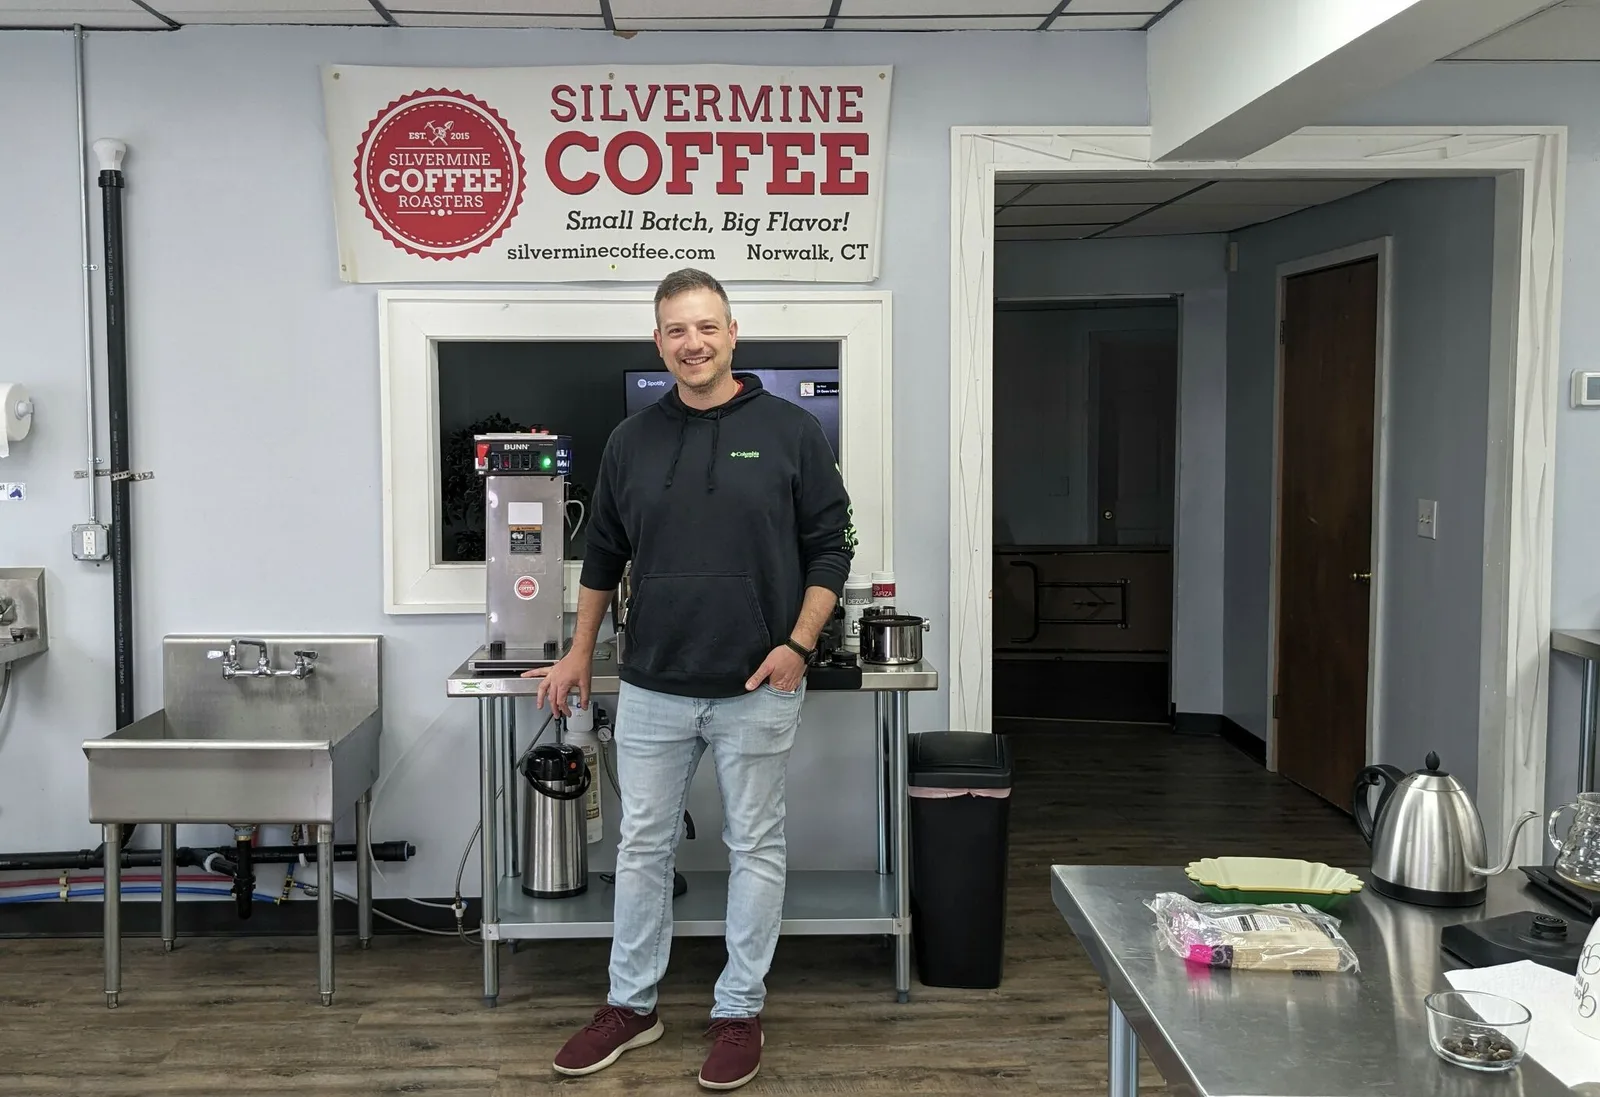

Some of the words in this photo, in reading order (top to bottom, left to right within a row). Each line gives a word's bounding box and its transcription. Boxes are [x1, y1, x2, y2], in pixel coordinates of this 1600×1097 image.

[550, 84, 864, 123] SILVERMINE
[408, 131, 427, 140] EST.
[450, 131, 470, 140] 2015
[388, 153, 491, 166] SILVERMINE
[545, 130, 869, 196] COFFEE
[378, 168, 502, 193] COFFEE
[398, 195, 484, 208] ROASTERS
[566, 210, 634, 231] Small
[640, 211, 714, 234] Batch,
[721, 212, 760, 236] Big
[766, 211, 850, 232] Flavor!
[507, 243, 715, 260] silverminecoffee.com
[746, 243, 835, 262] Norwalk,
[840, 243, 869, 260] CT
